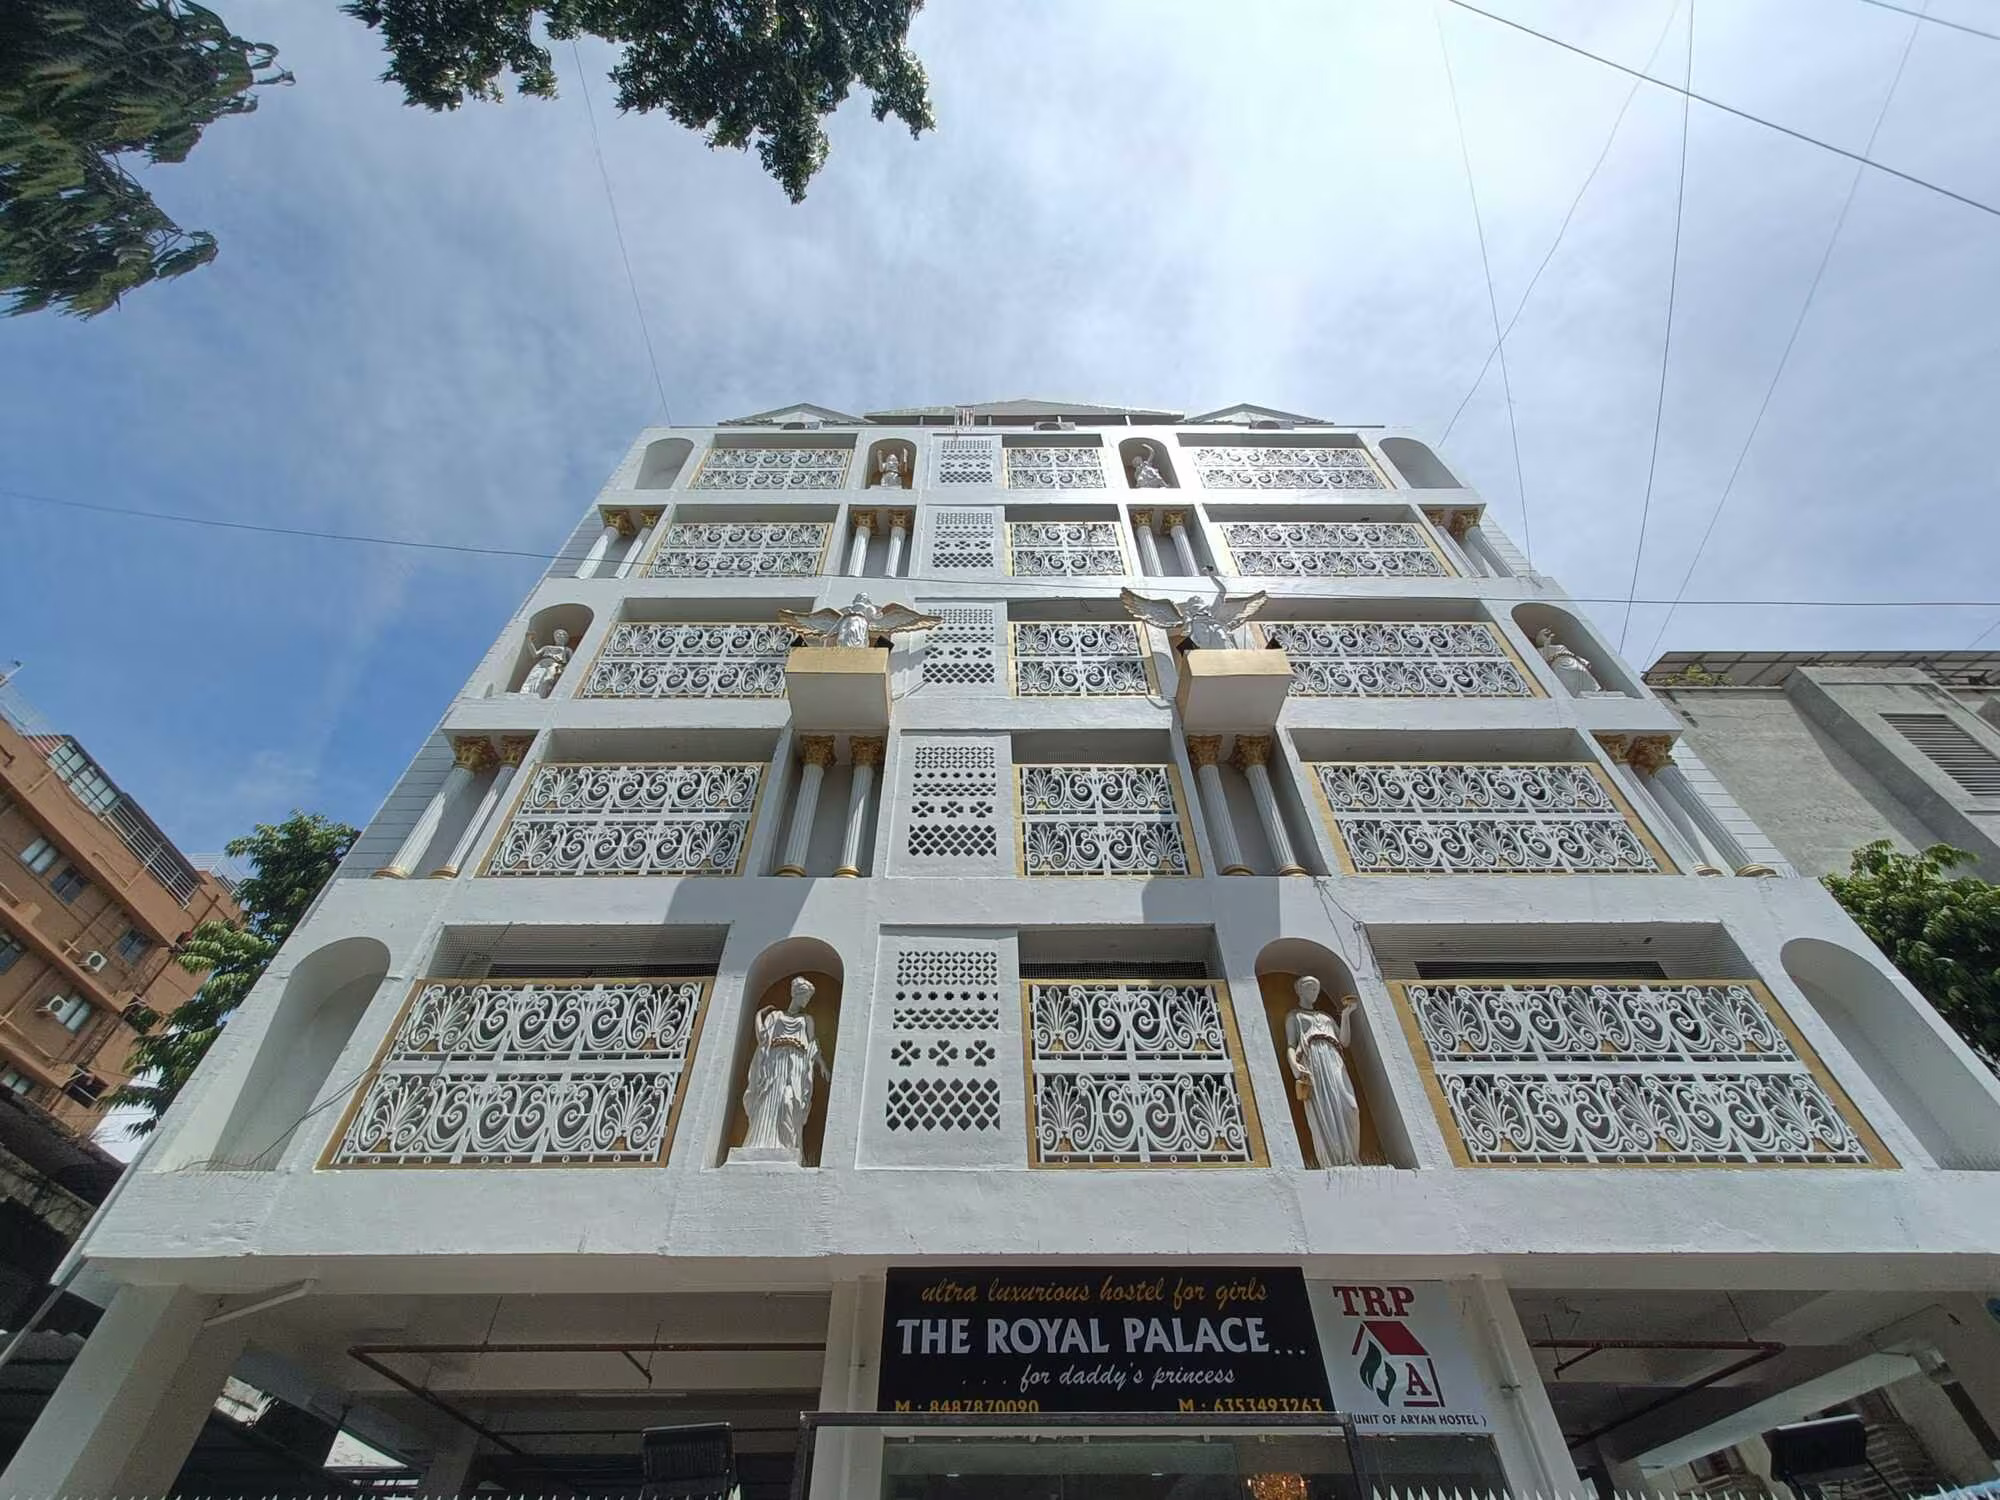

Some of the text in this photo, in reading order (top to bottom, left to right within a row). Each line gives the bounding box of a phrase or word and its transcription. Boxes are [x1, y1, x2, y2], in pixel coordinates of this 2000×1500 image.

[921, 1274, 1268, 1311] ultra luxurious hostel for girls
[1332, 1286, 1415, 1317] TRP
[896, 1318, 971, 1354] THE
[987, 1318, 1110, 1354] ROYAL
[1020, 1363, 1051, 1393] for
[1059, 1361, 1145, 1391] daddy's
[1151, 1367, 1236, 1391] princess
[1405, 1362, 1433, 1396] A
[1383, 1414, 1397, 1424] OF
[1401, 1414, 1436, 1425] ARYAN
